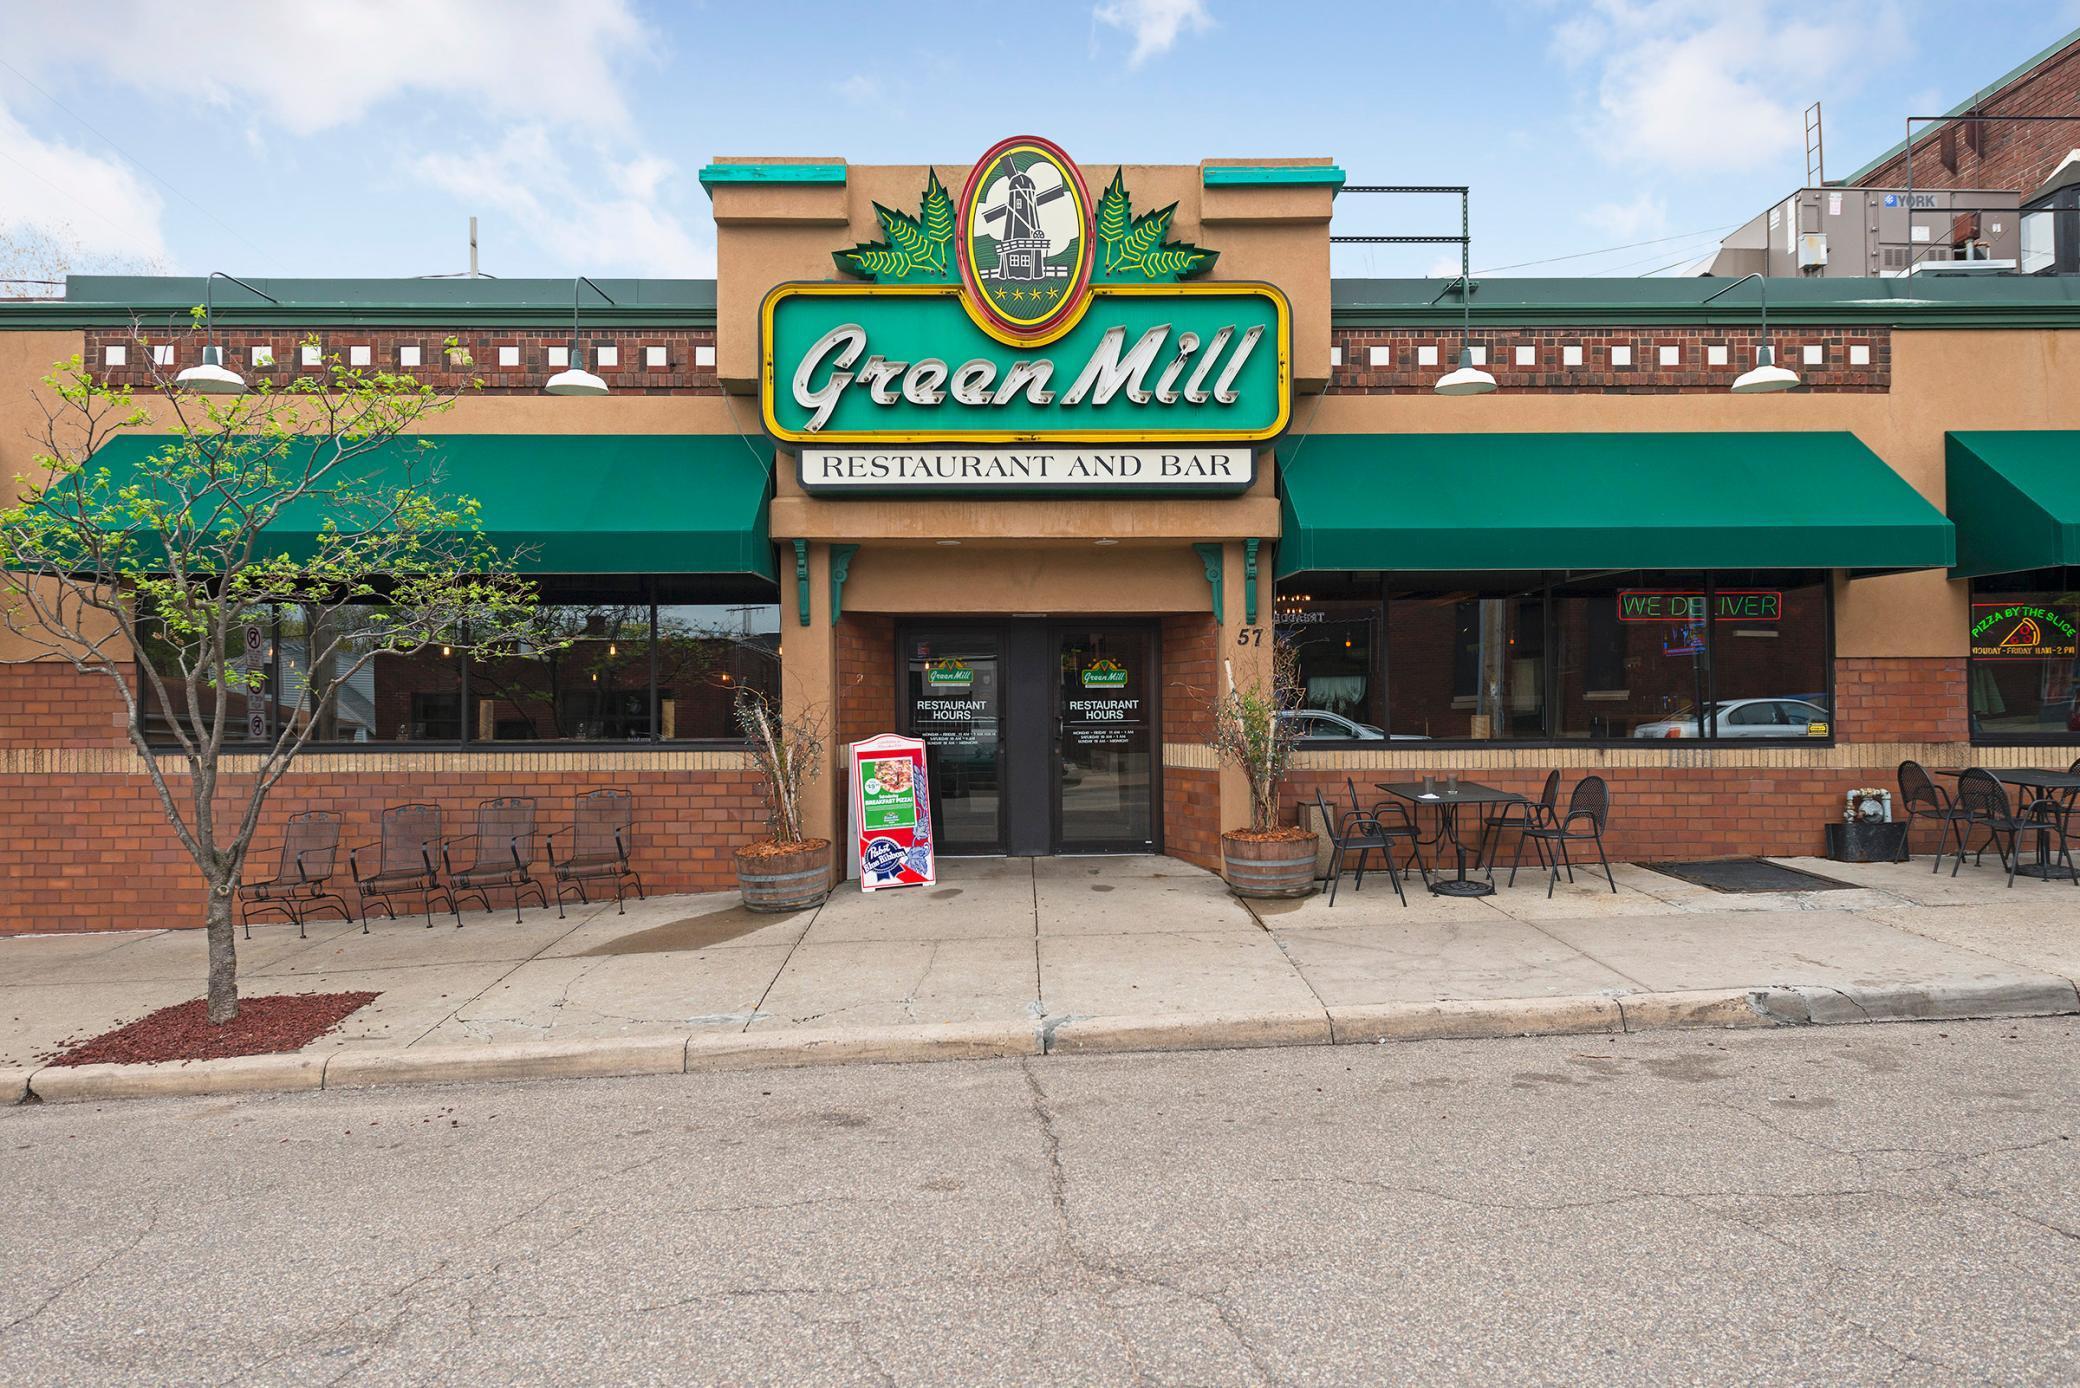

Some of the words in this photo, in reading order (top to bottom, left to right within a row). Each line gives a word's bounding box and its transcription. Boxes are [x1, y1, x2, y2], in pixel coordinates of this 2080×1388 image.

[1898, 195, 1936, 208] YORK
[792, 323, 1056, 434] Green
[1059, 323, 1266, 406] Mill
[821, 455, 1055, 478] RESTAURANT
[1067, 454, 1143, 478] AND
[1159, 453, 1233, 476] BAR
[1623, 596, 1662, 616] WE
[1671, 595, 1777, 616] DEIVER
[1971, 611, 2004, 638] PIZZA
[2004, 606, 2021, 618] BY
[2022, 606, 2046, 619] THE
[2046, 611, 2077, 638] SLICE
[1237, 628, 1263, 647] 57
[1972, 646, 2002, 655] MONDAY
[2006, 646, 2032, 655] FRIDAY
[930, 670, 953, 682] Green
[953, 671, 971, 679] Mill
[1084, 672, 1107, 683] Green
[1107, 672, 1125, 680] Mill
[917, 700, 987, 710] RESTAURANT
[1070, 700, 1139, 710] RESTAURANT
[933, 710, 971, 720] HOURS
[1086, 710, 1124, 720] HOURS
[868, 843, 891, 860] Pabst
[864, 860, 880, 873] Blue
[878, 851, 906, 864] Ribbon
